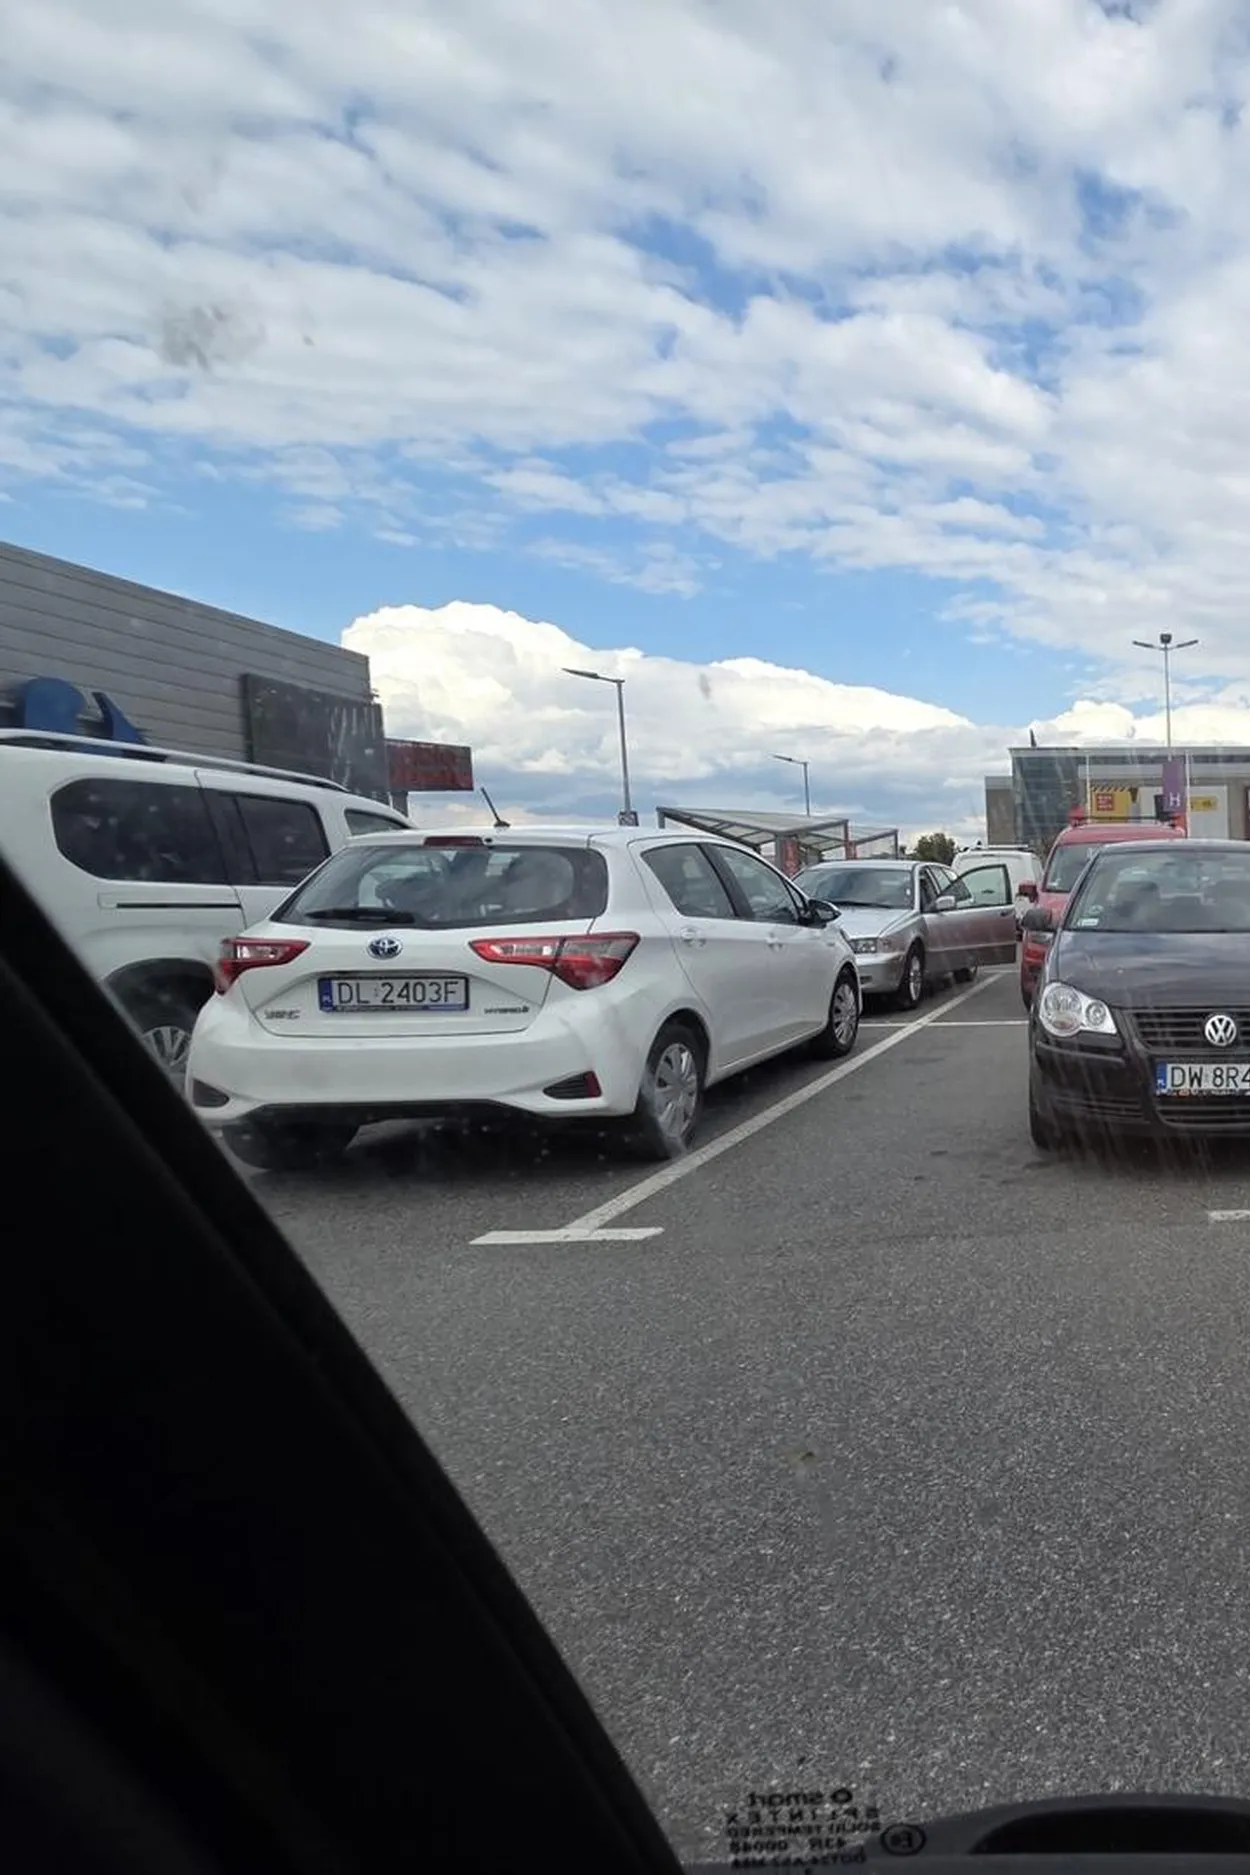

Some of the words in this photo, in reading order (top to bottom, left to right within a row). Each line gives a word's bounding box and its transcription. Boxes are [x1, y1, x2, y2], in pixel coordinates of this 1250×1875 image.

[1168, 791, 1182, 808] H
[337, 982, 370, 1004] DL
[381, 981, 459, 1004] 2403F
[1170, 1066, 1203, 1088] DW
